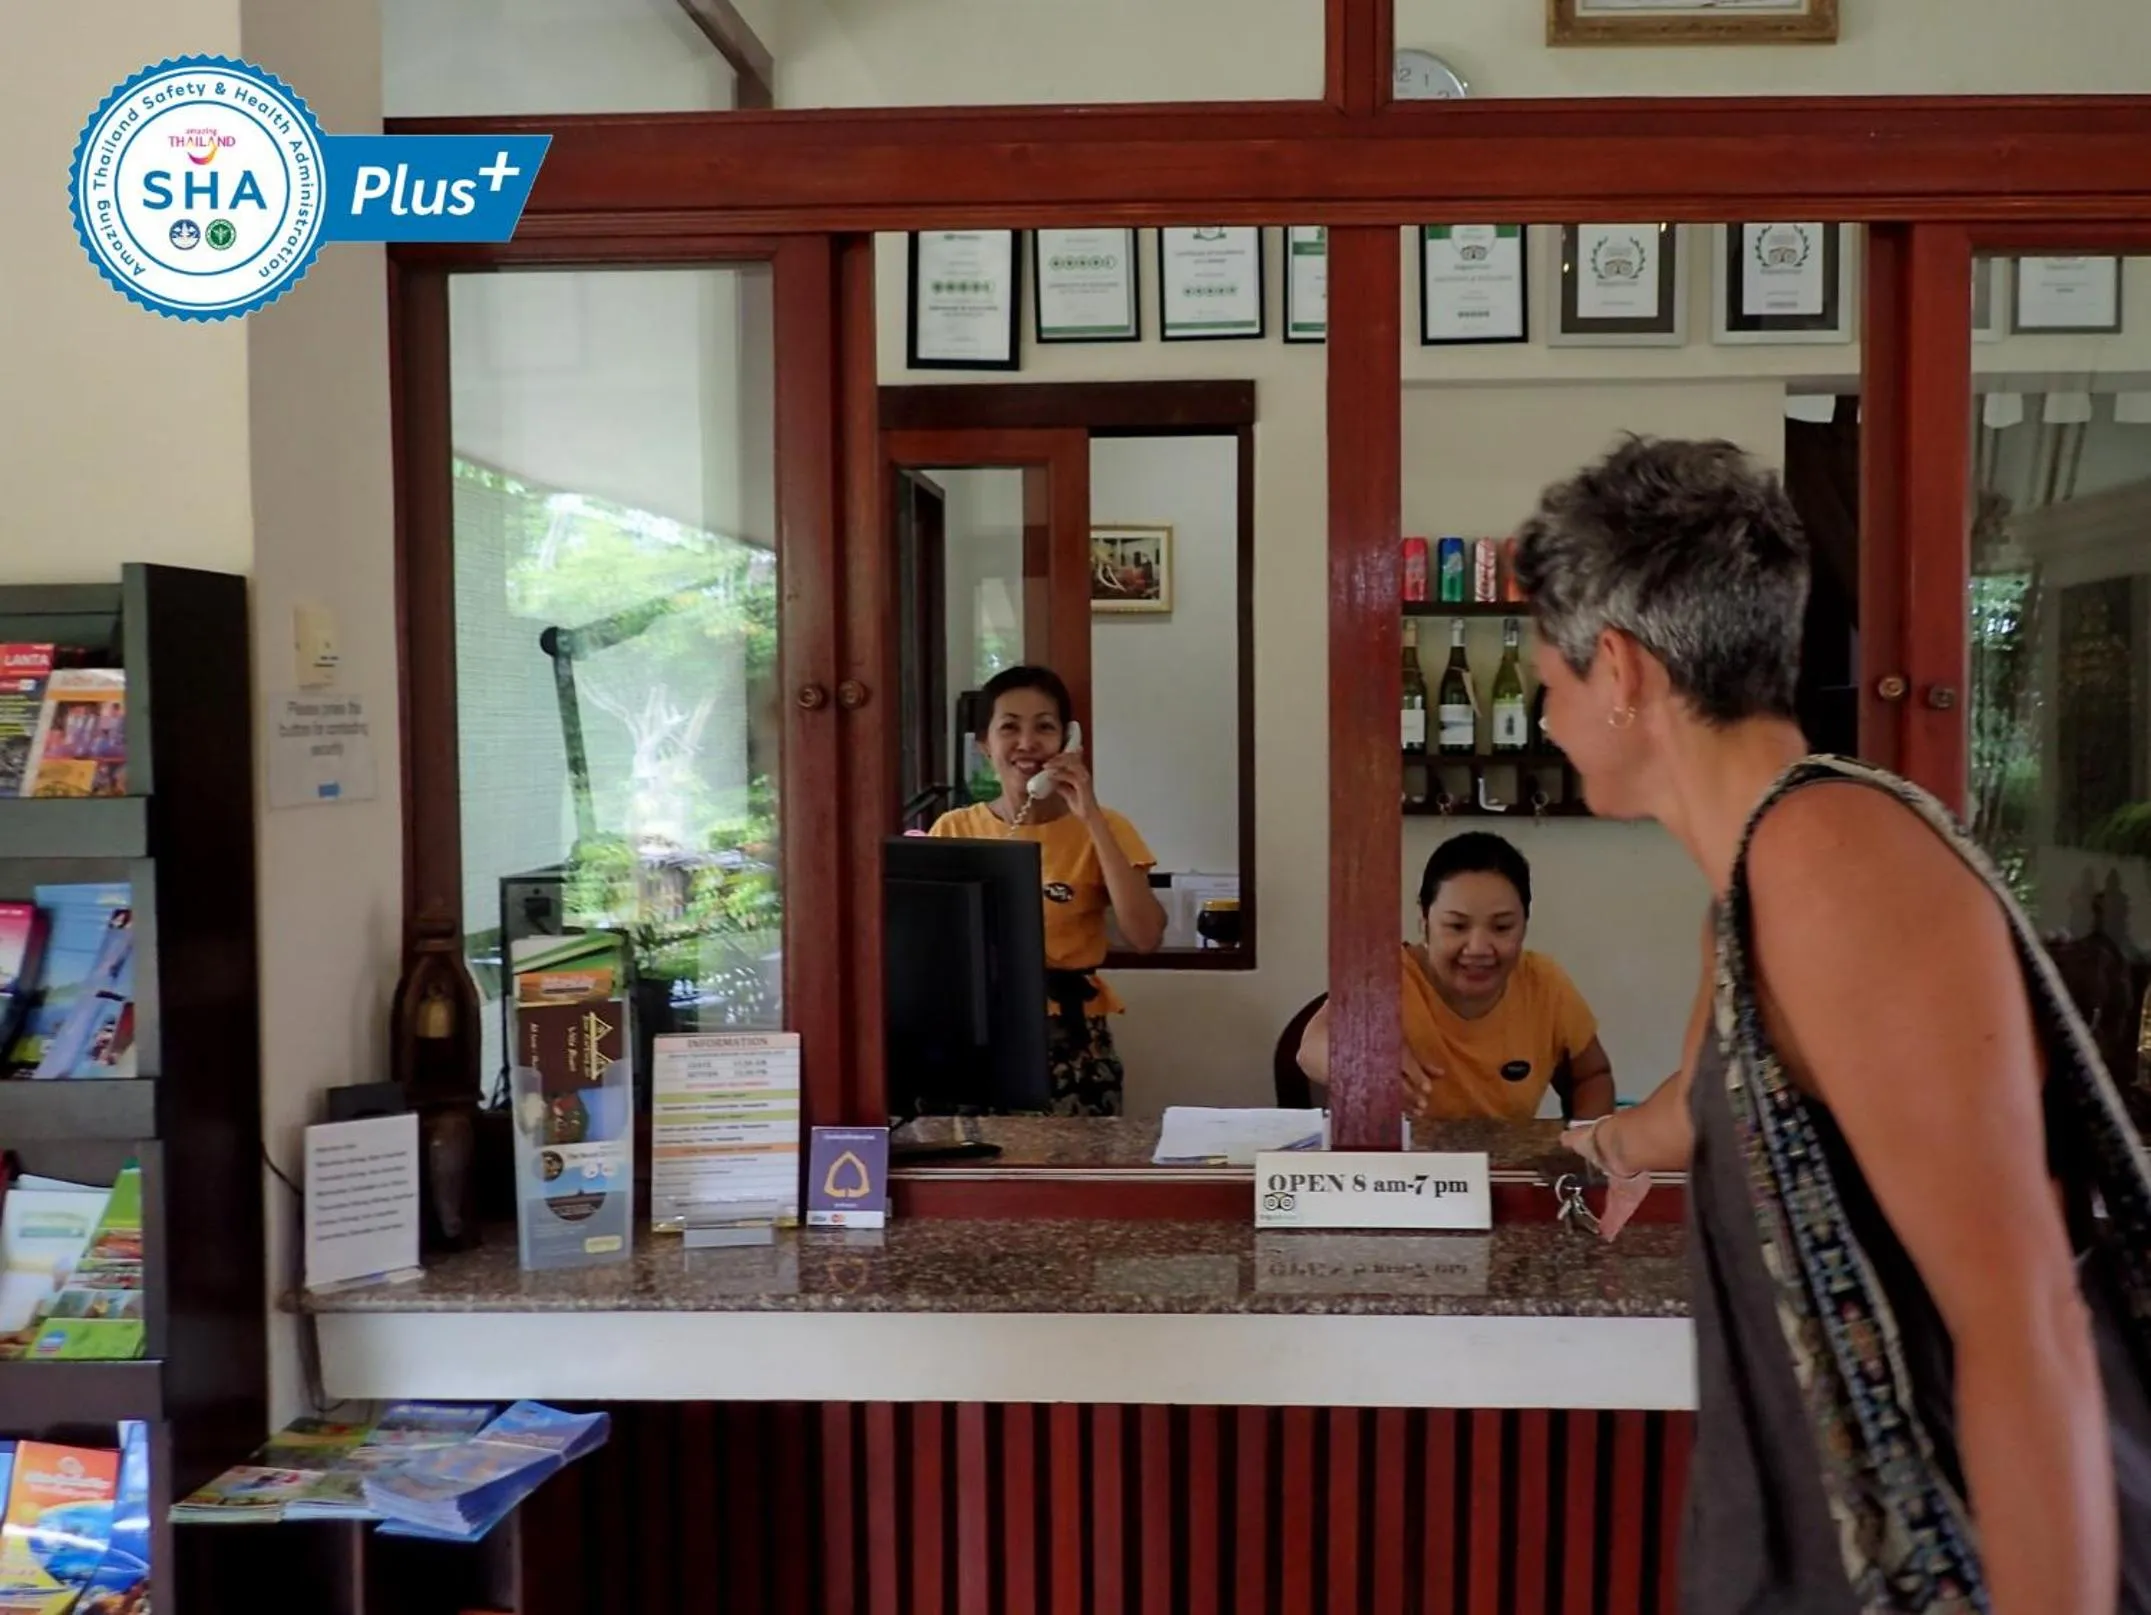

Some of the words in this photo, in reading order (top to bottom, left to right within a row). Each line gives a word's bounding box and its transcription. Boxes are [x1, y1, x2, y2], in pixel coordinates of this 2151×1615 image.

[687, 1037, 769, 1048] INFORMATION
[1267, 1173, 1345, 1193] OPEN
[1352, 1173, 1367, 1193] 8
[1373, 1174, 1429, 1195] am-7
[1433, 1179, 1469, 1198] pm
